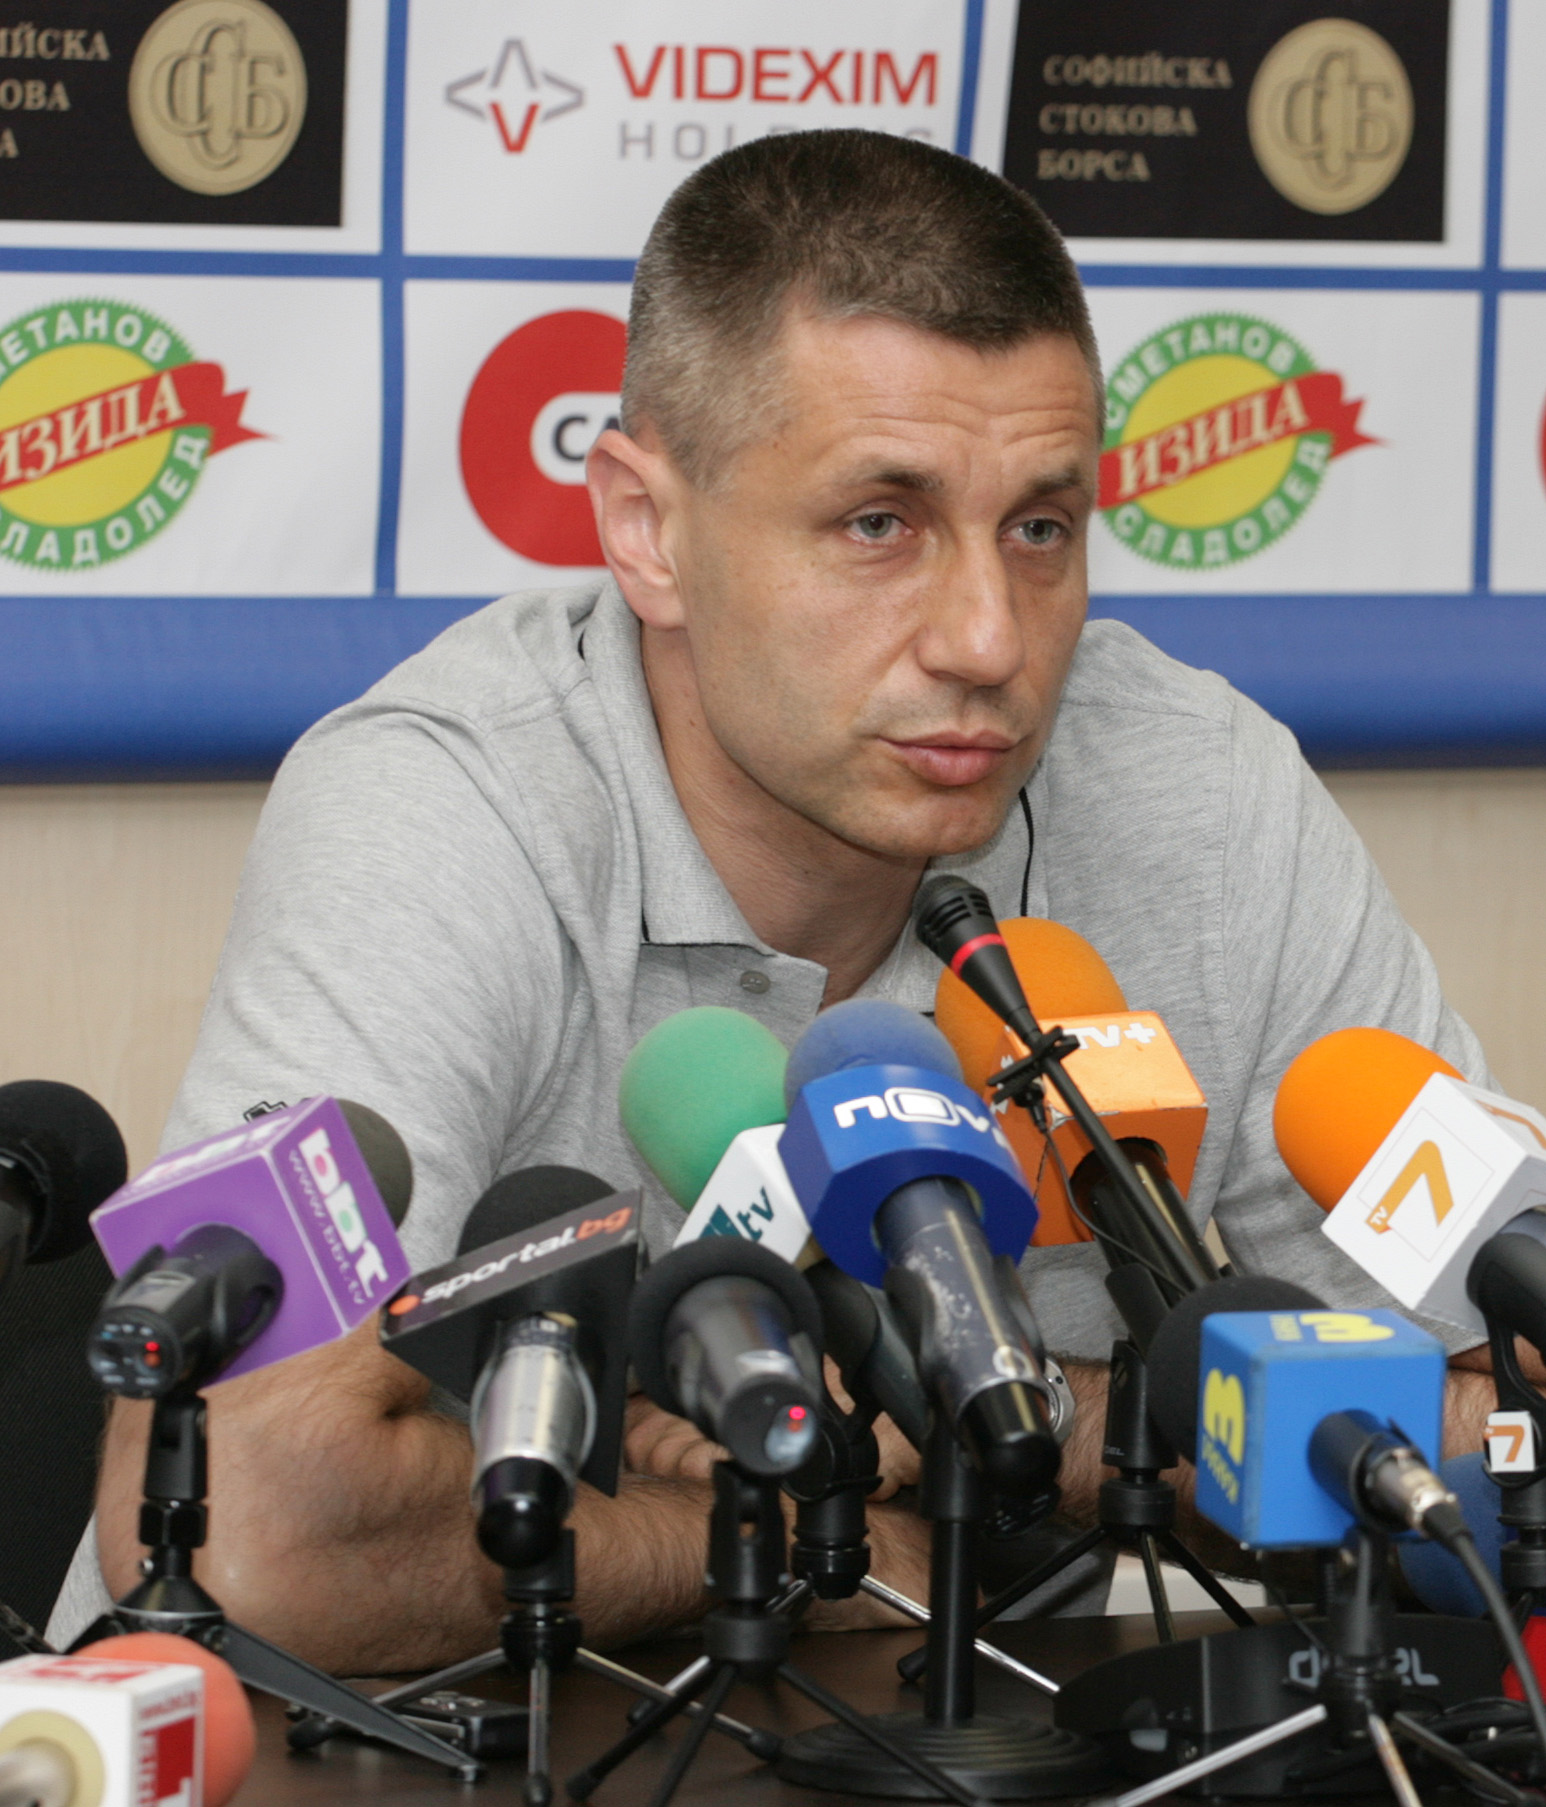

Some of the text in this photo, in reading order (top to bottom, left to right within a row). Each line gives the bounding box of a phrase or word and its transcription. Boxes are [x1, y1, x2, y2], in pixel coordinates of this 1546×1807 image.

[612, 43, 939, 106] VIDEXIM
[1043, 51, 1234, 88] СОФИЙСКА
[1039, 103, 1199, 137] СТОКОВА
[1036, 149, 1152, 182] БОРСА
[1116, 381, 1309, 499] ИЗИДА
[1113, 440, 1332, 563] СЛАДОЛЕД
[289, 1149, 366, 1305] www.bbt.tv
[299, 1127, 389, 1299] bbt
